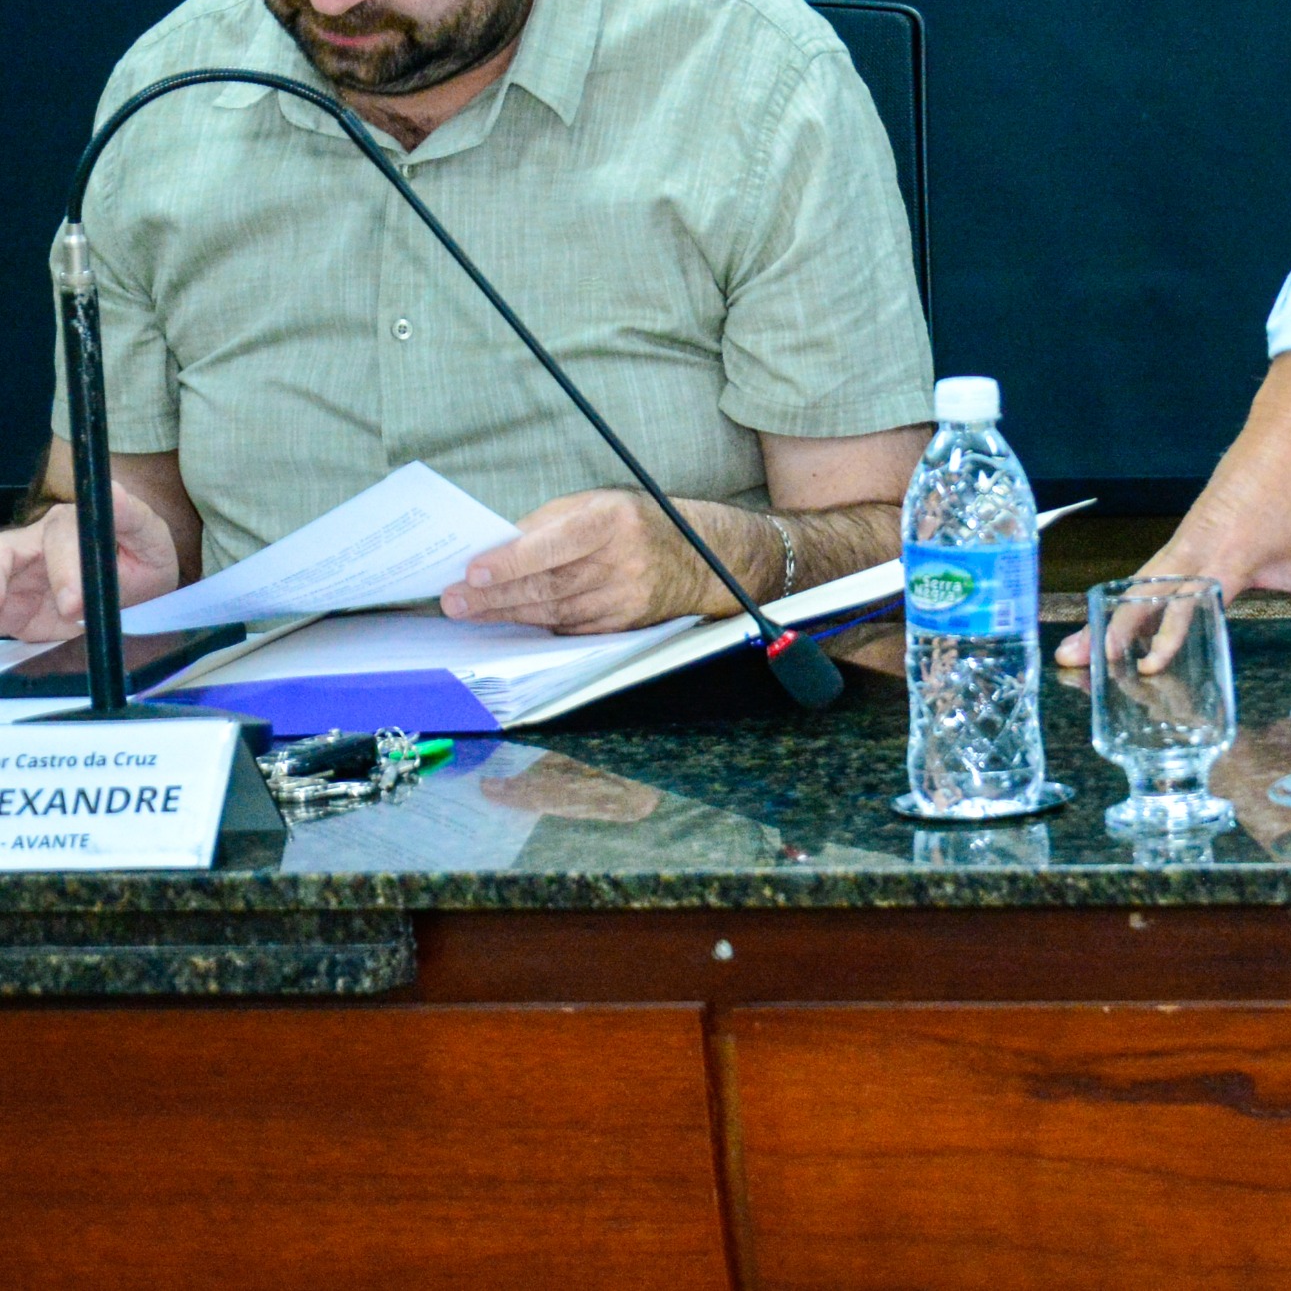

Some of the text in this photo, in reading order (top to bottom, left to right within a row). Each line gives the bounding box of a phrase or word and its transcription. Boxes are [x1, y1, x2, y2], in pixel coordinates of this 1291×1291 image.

[923, 575, 963, 591] Serra
[914, 584, 956, 602] Negra
[15, 753, 77, 768] Castro
[83, 752, 106, 767] da
[113, 751, 157, 766] Cruz
[0, 785, 182, 815] EXANDRE
[11, 833, 90, 849] AVANTE
